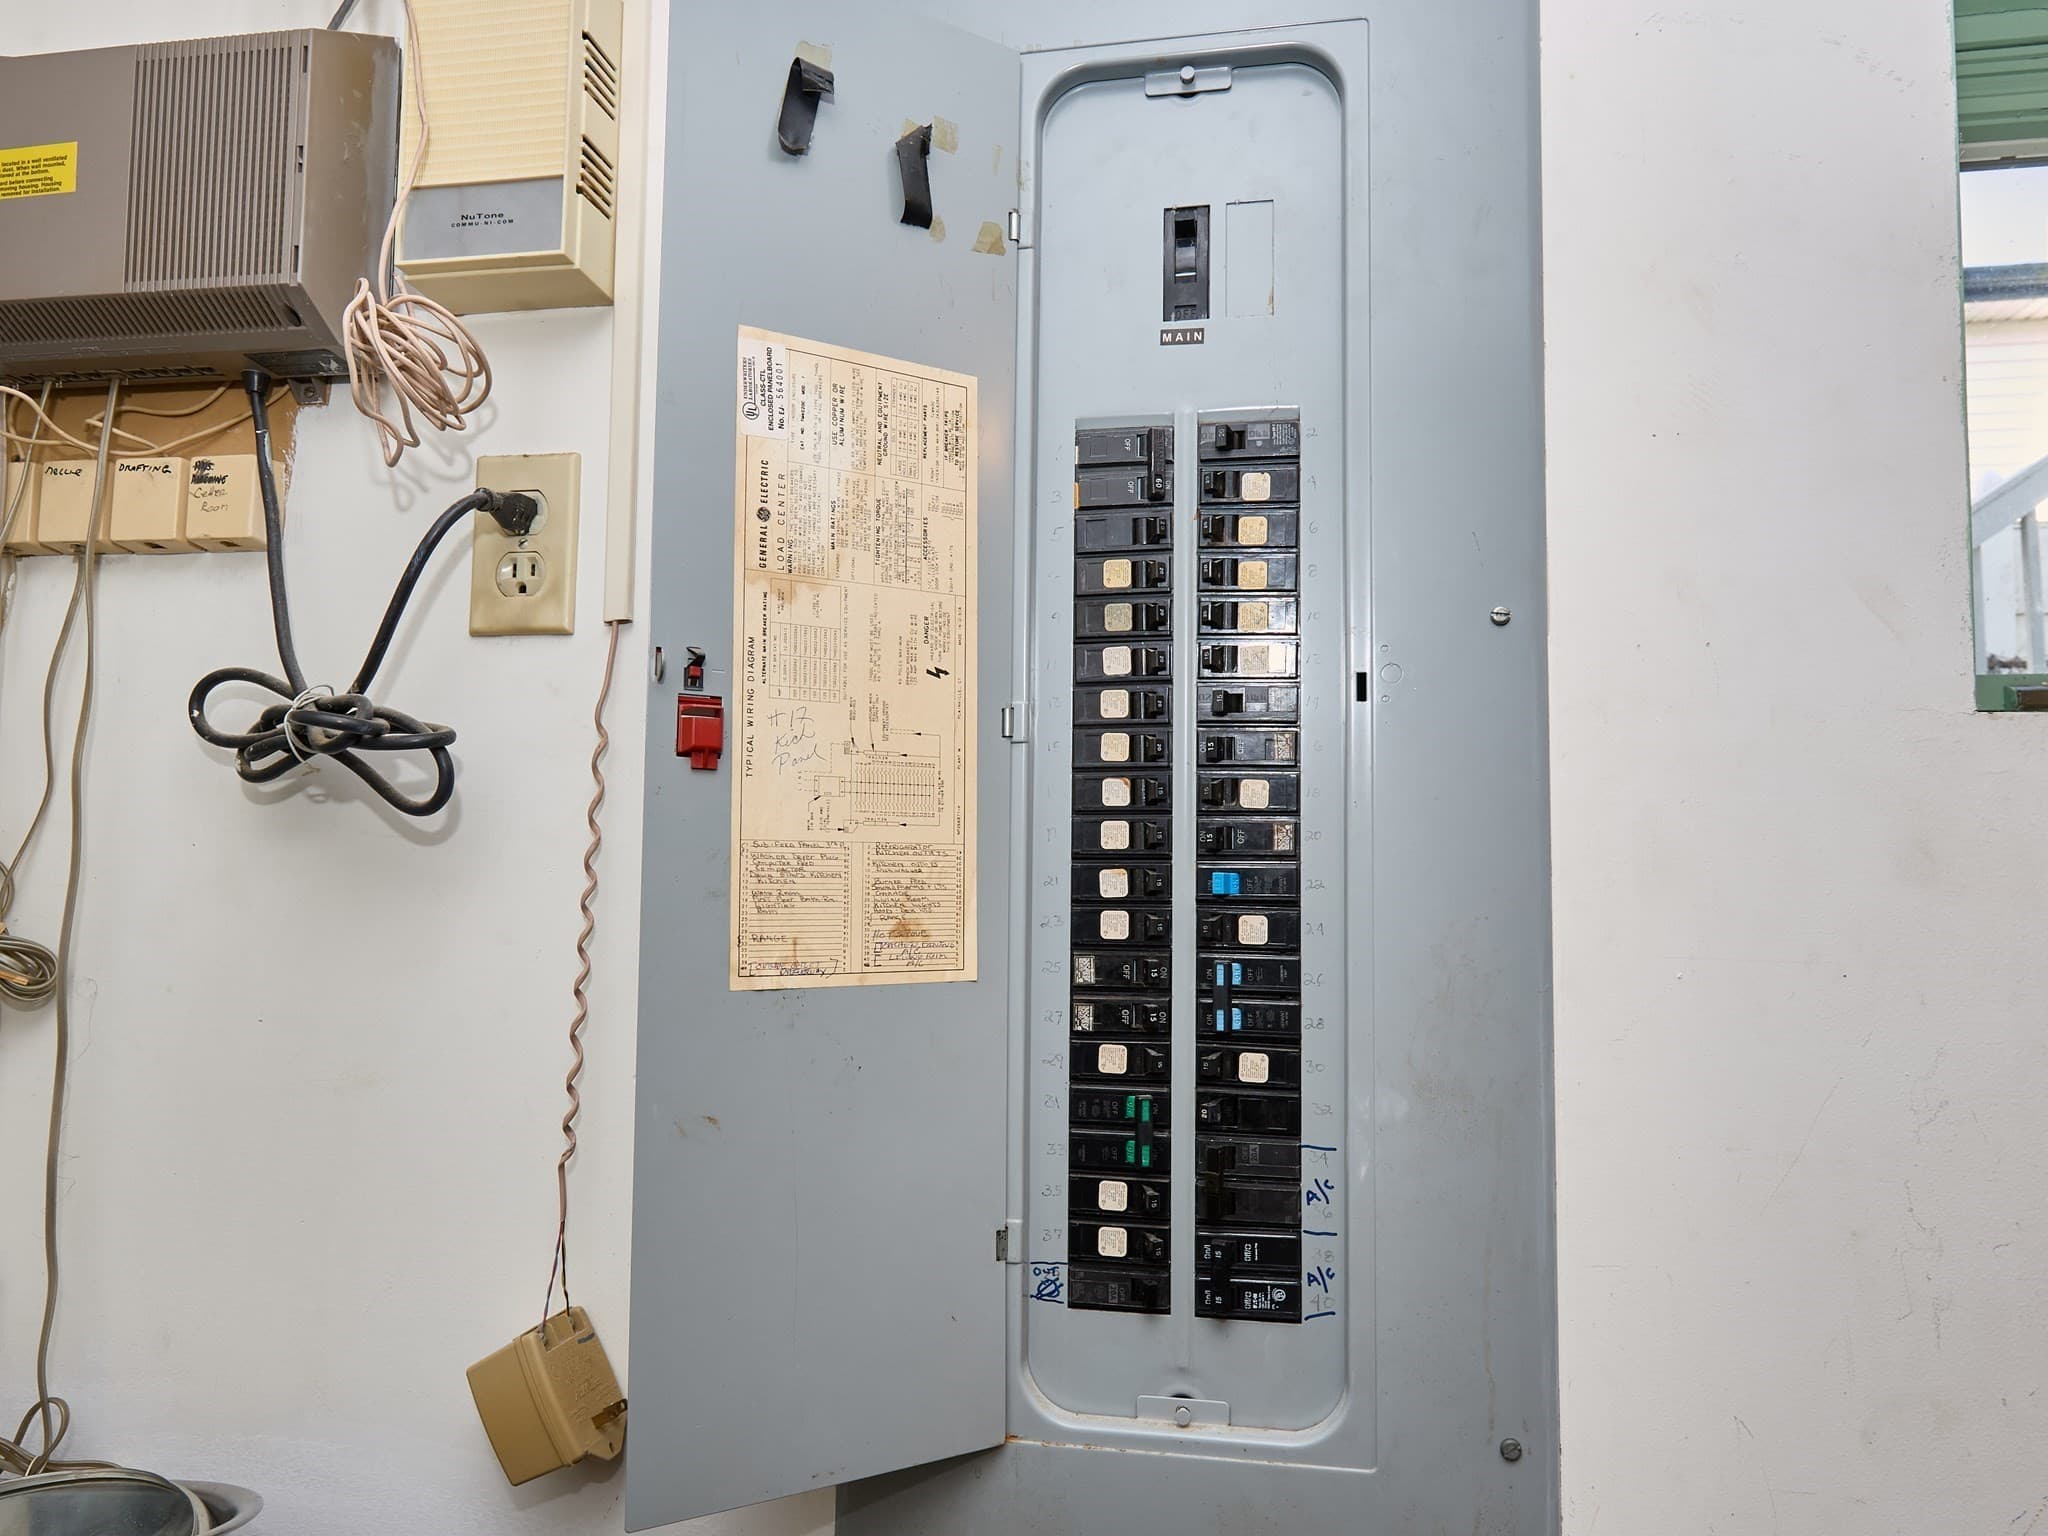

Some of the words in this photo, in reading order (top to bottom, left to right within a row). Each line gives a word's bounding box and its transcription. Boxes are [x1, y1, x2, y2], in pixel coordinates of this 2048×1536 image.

[460, 212, 505, 221] NuTone
[1162, 331, 1204, 343] MAIN
[766, 346, 774, 393] PANELBOARD
[759, 368, 767, 407] CLASS-CTL
[774, 362, 785, 400] 564001
[832, 382, 839, 393] OR
[767, 394, 775, 431] ENCLOSED
[777, 417, 785, 430] No.
[118, 463, 173, 474] DRAFTING
[759, 458, 770, 504] ELECTRIC
[1127, 480, 1135, 494] OFF
[1155, 478, 1163, 488] 60
[777, 472, 786, 526] CENTER
[758, 524, 769, 569] GENERAL
[776, 536, 785, 571] LOAD
[746, 636, 756, 682] DIAGRAM
[746, 688, 755, 727] WIRING
[1207, 742, 1215, 751] 15
[745, 734, 754, 778] TYPICAL
[1206, 833, 1214, 843] 15
[1236, 829, 1245, 845] OFF
[751, 934, 788, 943] RANGE
[1122, 964, 1130, 980] OFF
[1150, 968, 1159, 978] 15
[1159, 966, 1168, 979] ON
[1121, 1009, 1130, 1025] OFF
[1149, 1013, 1158, 1022] 15
[1158, 1011, 1167, 1024] ON
[1201, 1108, 1209, 1119] 20
[1306, 1178, 1335, 1206] A/C
[1214, 1250, 1222, 1259] 15
[1307, 1265, 1336, 1294] A/C
[1214, 1295, 1222, 1305] 15
